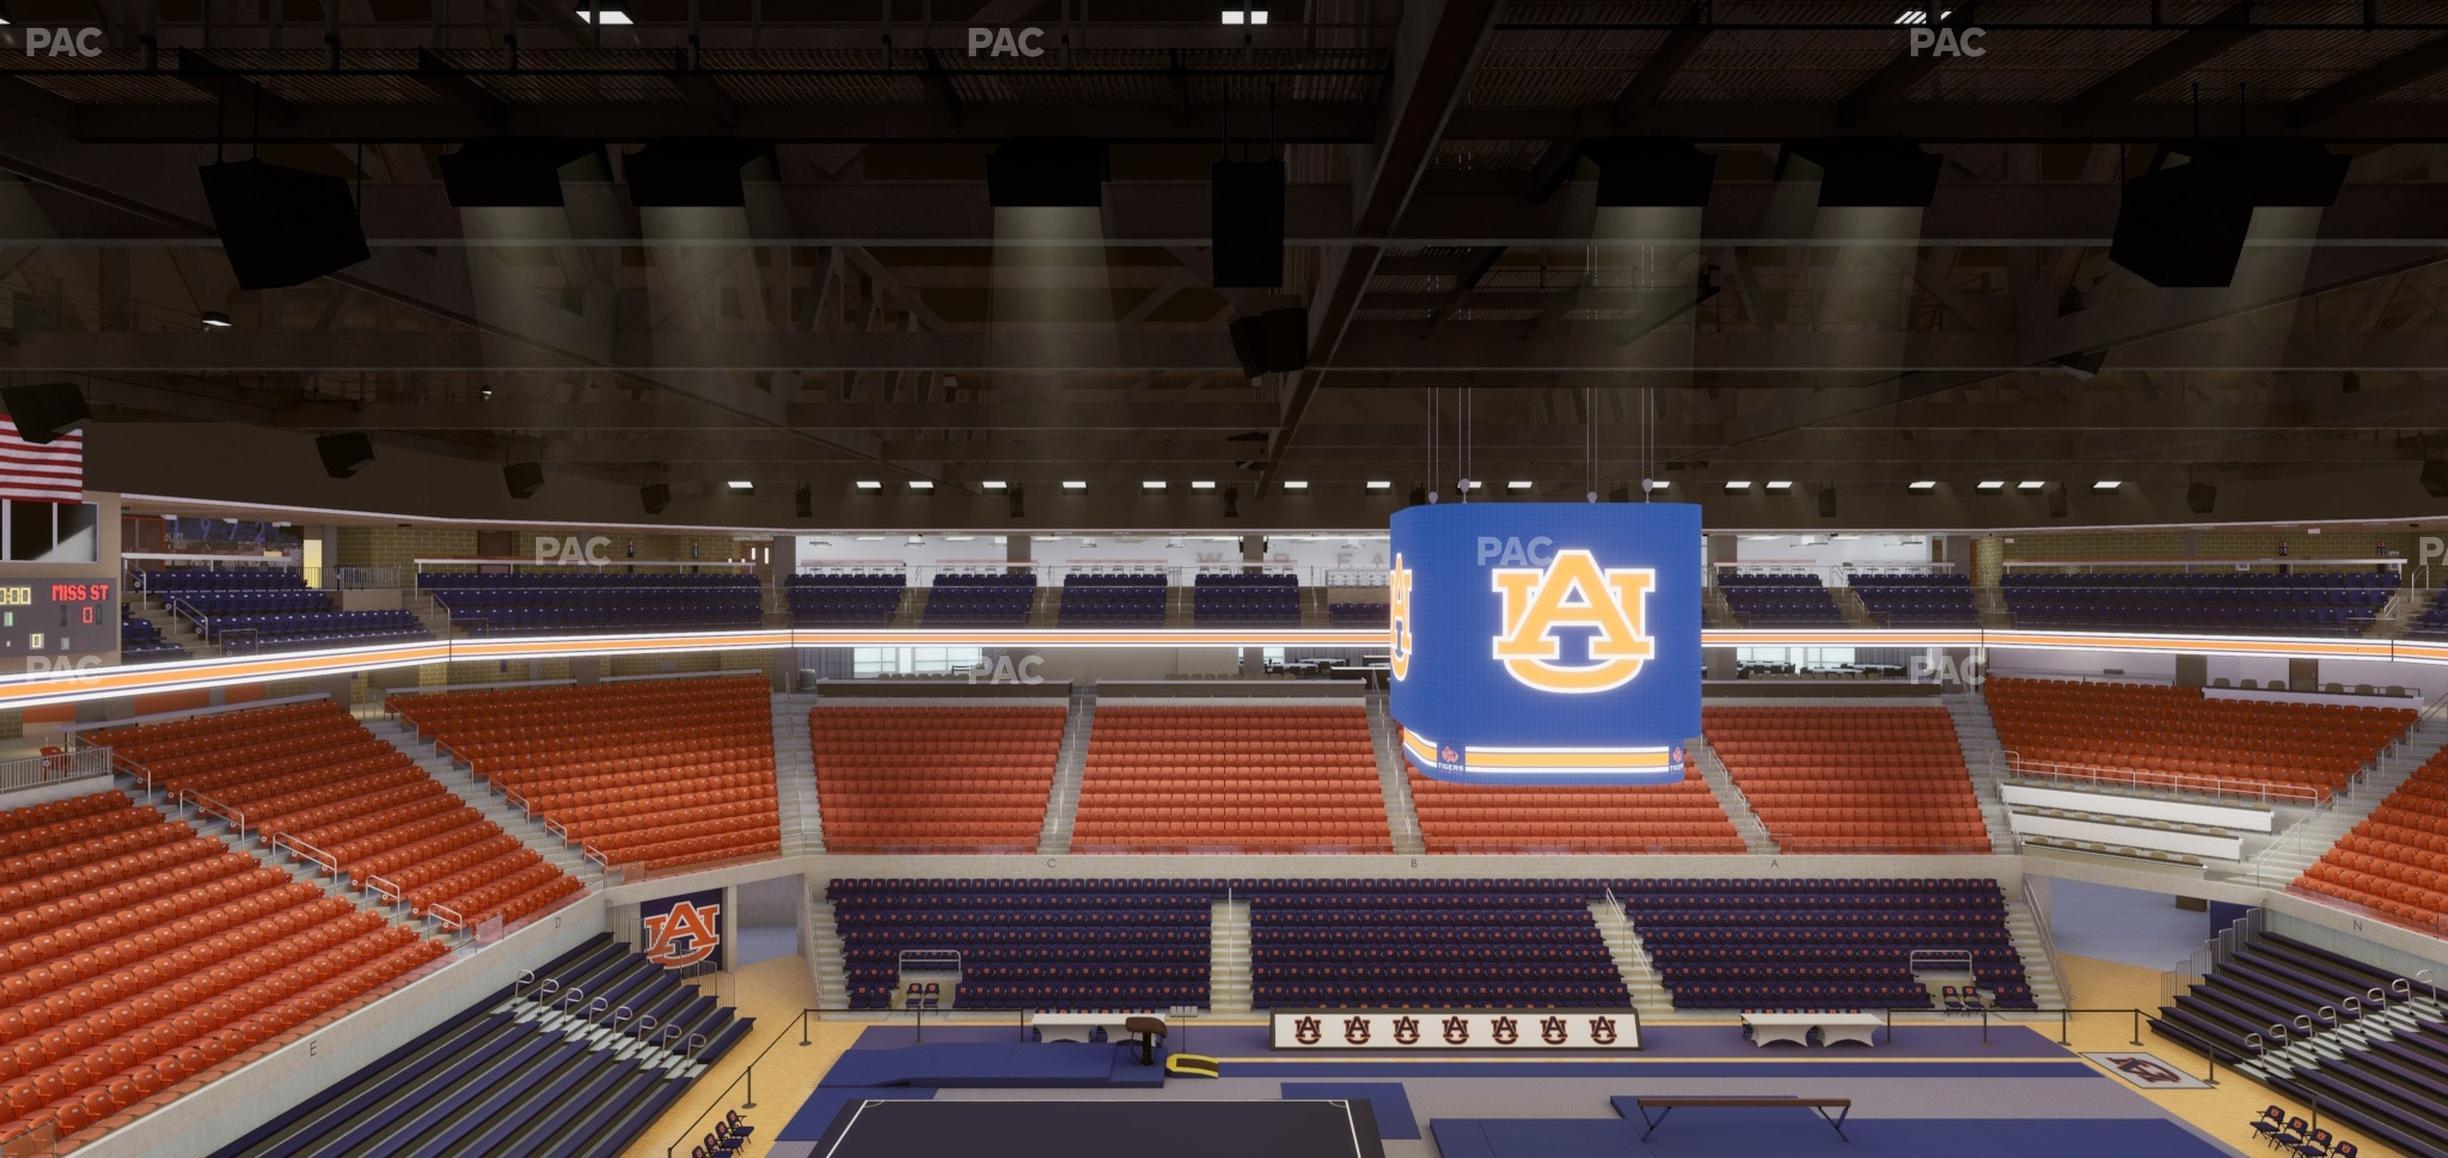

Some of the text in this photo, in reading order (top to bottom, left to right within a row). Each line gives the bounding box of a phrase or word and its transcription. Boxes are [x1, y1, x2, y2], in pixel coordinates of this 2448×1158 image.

[51, 584, 109, 601] MISS ST
[82, 606, 93, 624] 0
[1438, 762, 1464, 772] TIGERS
[1047, 858, 1056, 869] C
[1411, 858, 1417, 868] B
[1770, 858, 1779, 868] A
[555, 916, 561, 929] D
[2353, 919, 2362, 932] N
[310, 1040, 316, 1057] E
